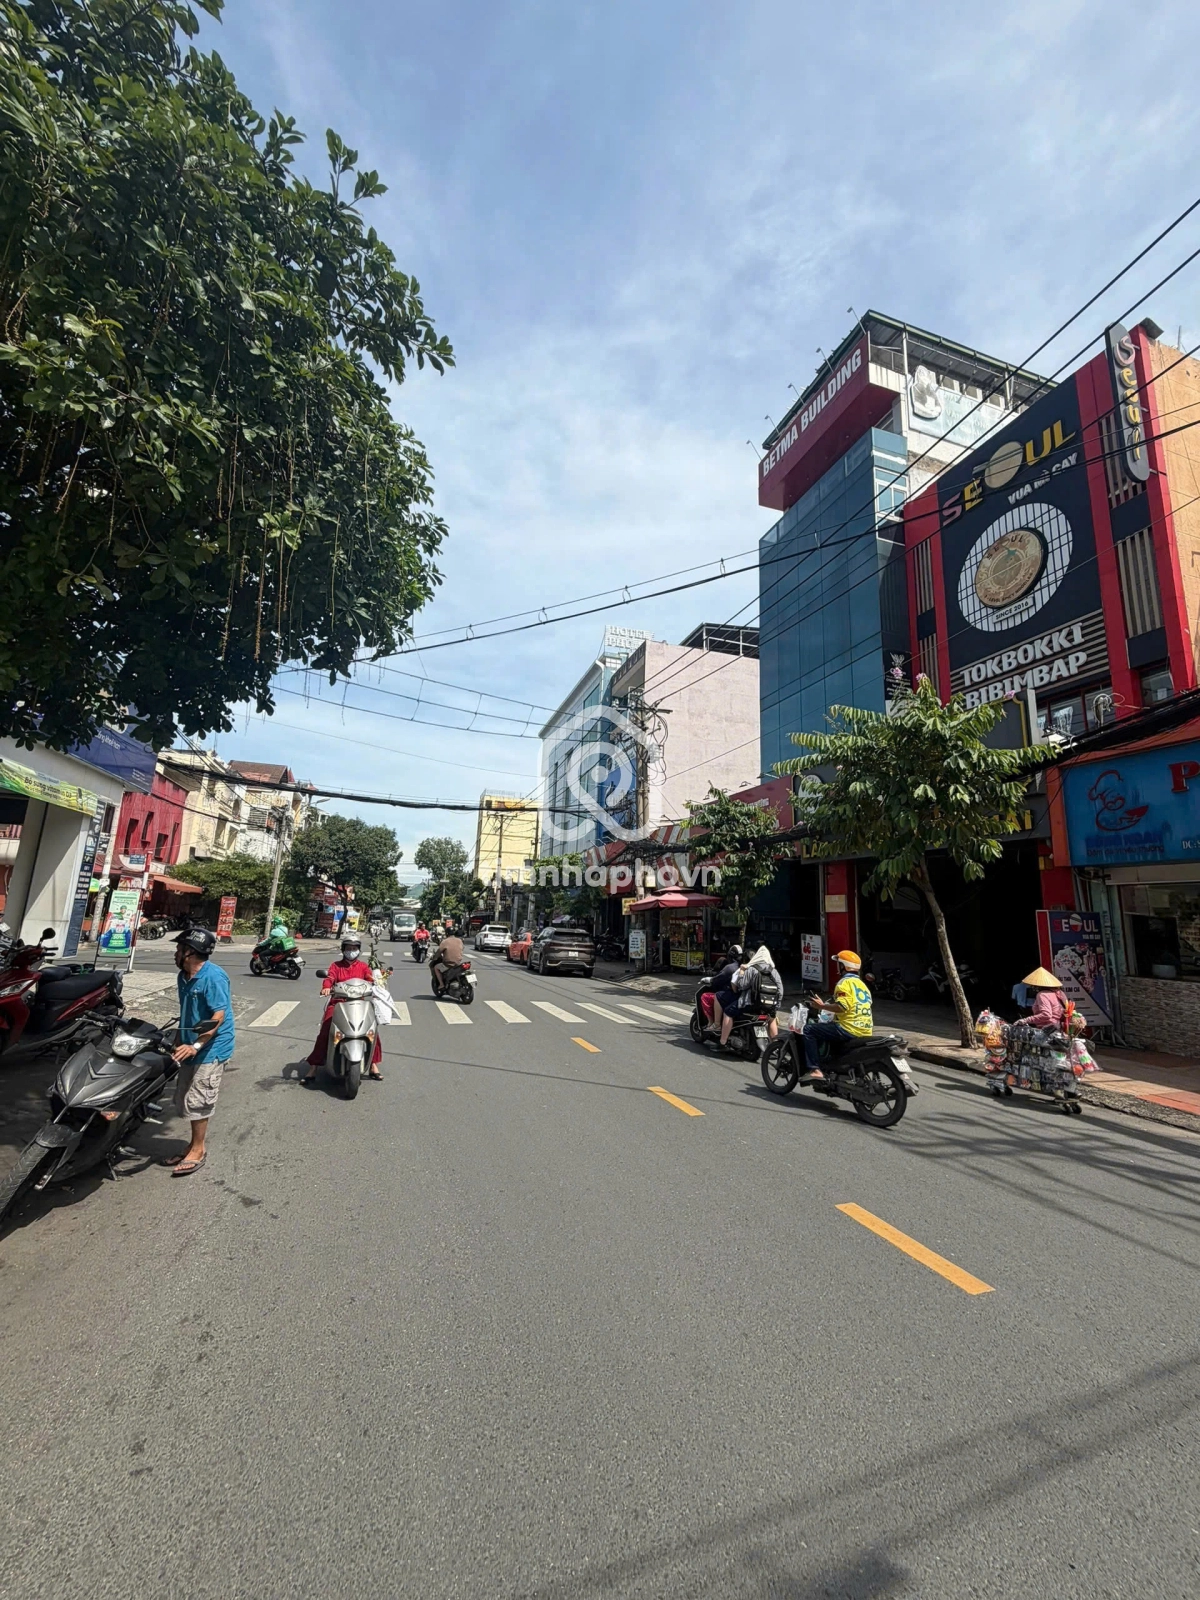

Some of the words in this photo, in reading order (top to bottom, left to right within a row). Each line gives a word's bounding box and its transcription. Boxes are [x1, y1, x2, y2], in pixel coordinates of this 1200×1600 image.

[762, 424, 799, 477] BETMA
[800, 348, 862, 433] BUILDING
[1007, 484, 1033, 504] VUA
[1051, 452, 1078, 477] CAY
[995, 608, 1013, 620] SINCE
[1013, 600, 1029, 612] 2016
[960, 623, 1085, 687] TOKBOKKI
[965, 652, 1088, 710] BIBIMBAP
